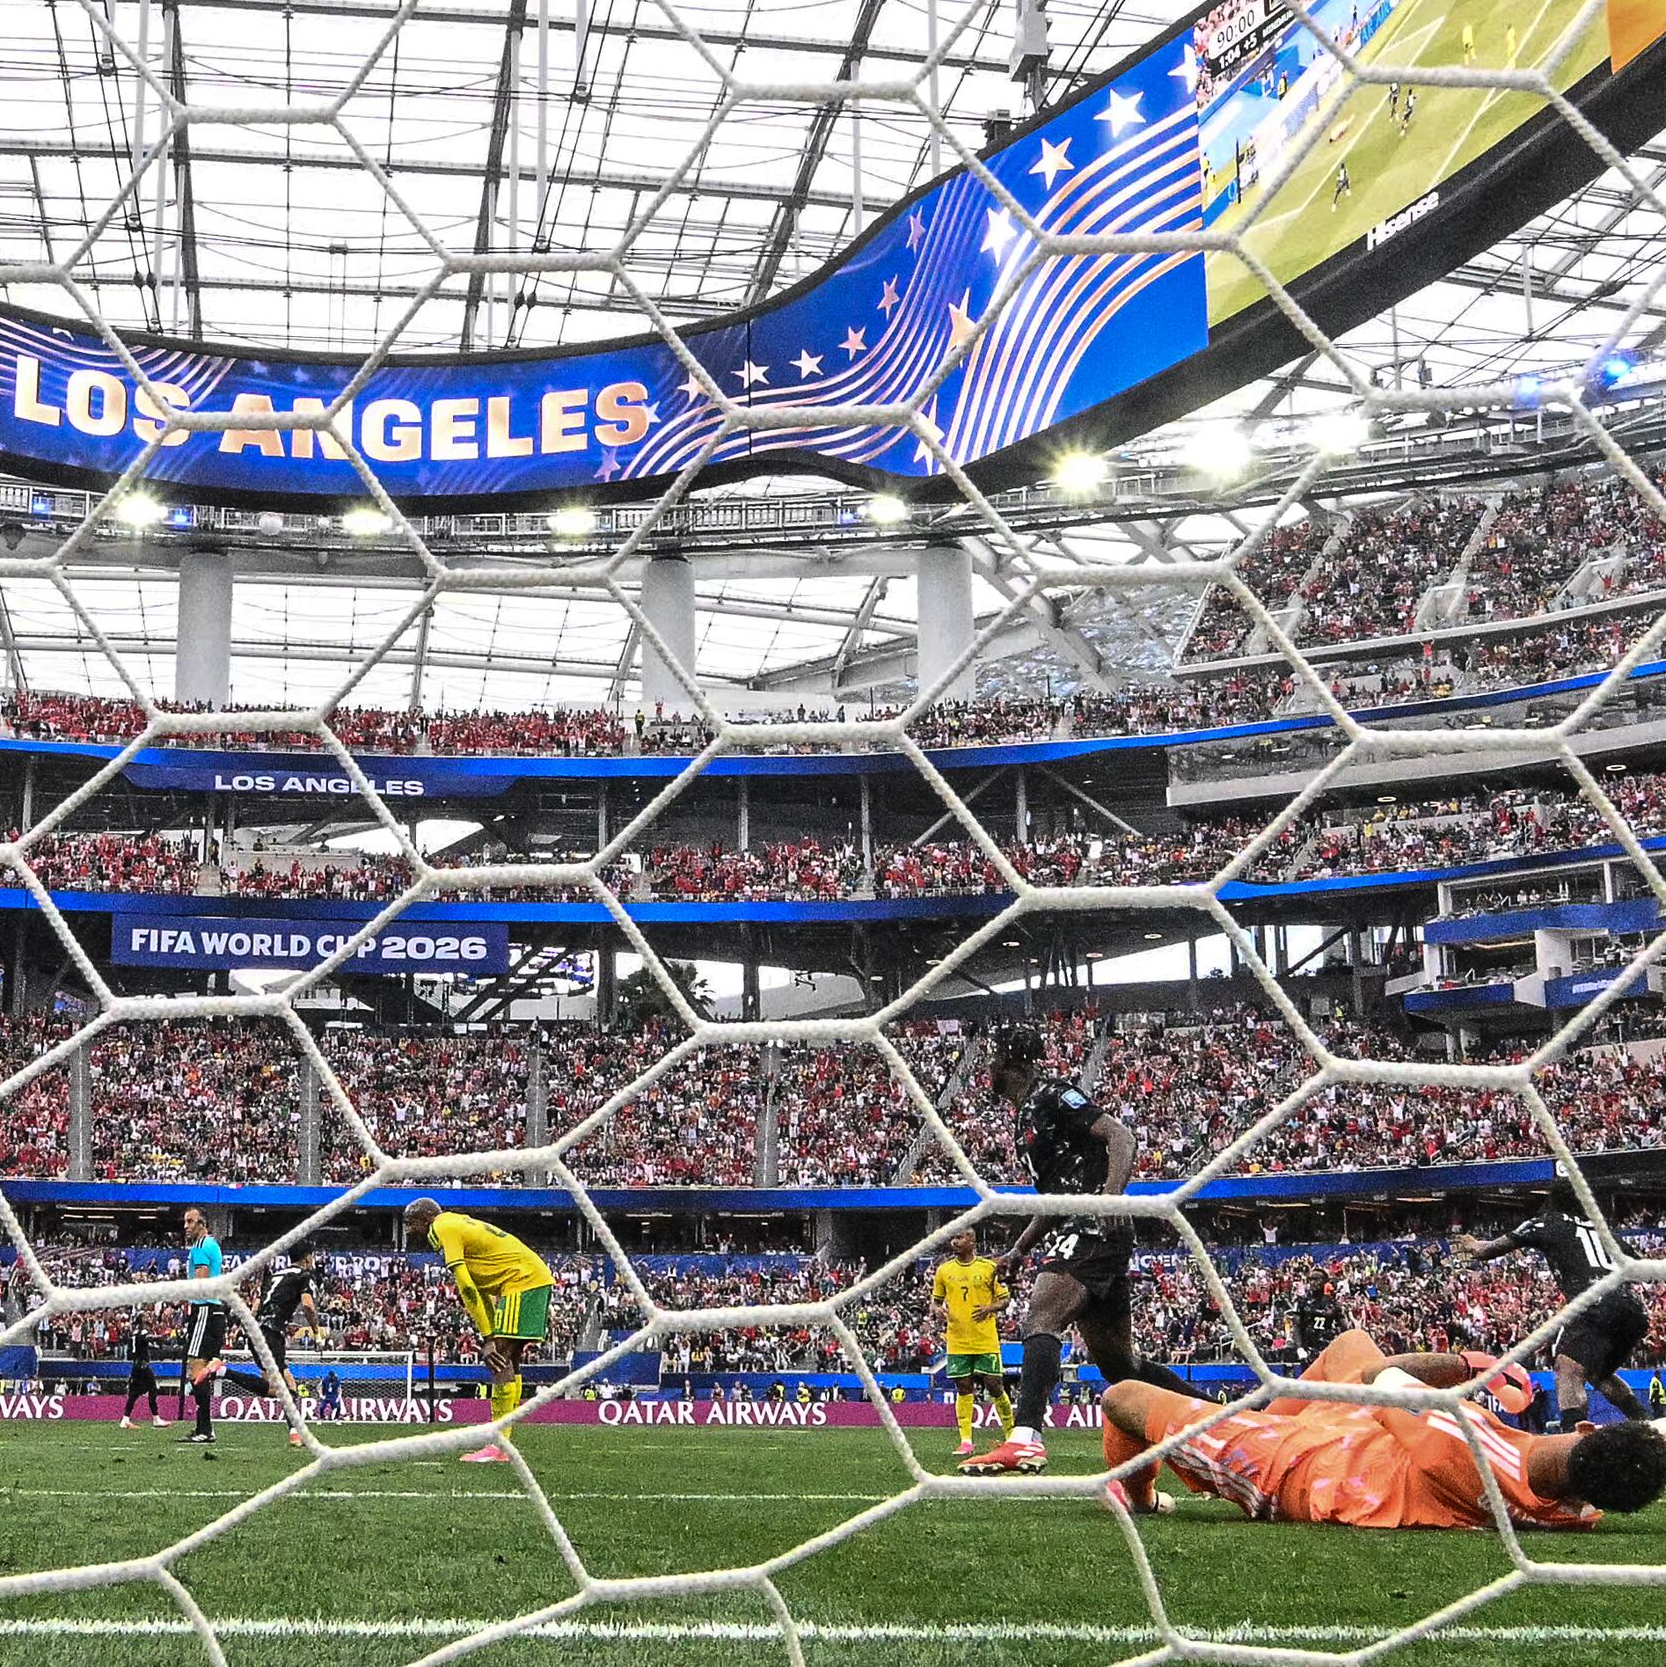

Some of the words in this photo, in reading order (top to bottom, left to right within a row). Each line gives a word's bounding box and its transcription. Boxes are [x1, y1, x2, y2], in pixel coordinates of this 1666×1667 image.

[1216, 9, 1256, 49] 90:00
[1218, 43, 1242, 70] 1:04
[1366, 191, 1439, 251] Hisense
[13, 354, 191, 447] LOS
[218, 382, 651, 463] ANGELES
[214, 774, 275, 792] LOS
[131, 928, 196, 954] FIFA
[200, 932, 311, 957] WORLD
[381, 936, 487, 960] 2026
[960, 1286, 969, 1302] 7
[1313, 1317, 1326, 1331] 22
[598, 1400, 696, 1426] QATAR
[706, 1401, 828, 1426] AIRWAYS
